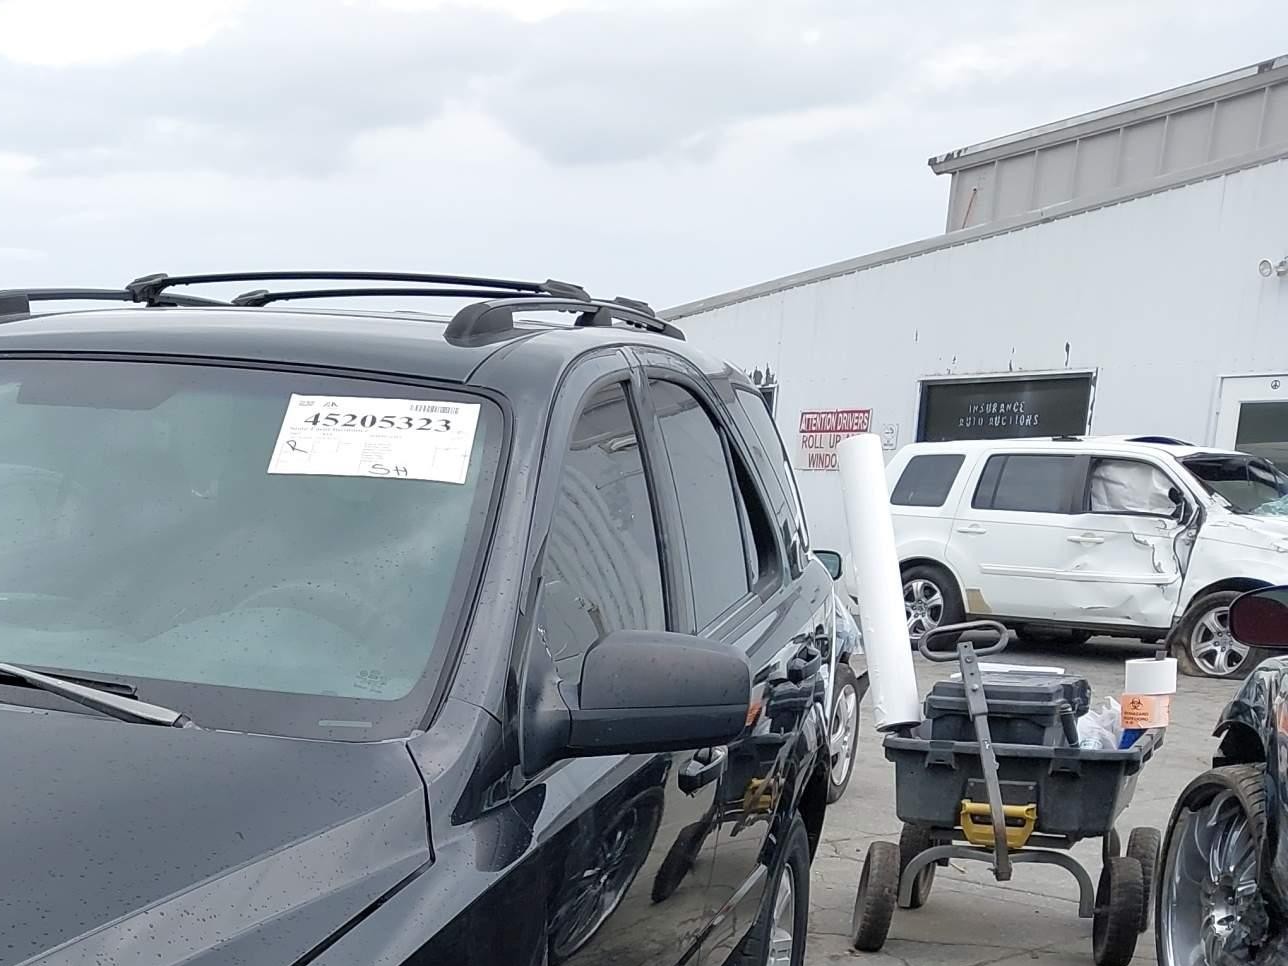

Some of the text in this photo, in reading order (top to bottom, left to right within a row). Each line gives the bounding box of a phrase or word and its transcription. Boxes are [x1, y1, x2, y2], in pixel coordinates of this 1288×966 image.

[968, 401, 1025, 415] INSURANCE
[304, 412, 452, 432] 45205323
[800, 411, 869, 431] ATTENTION DRIVERS
[802, 434, 841, 448] ROLL UP
[808, 453, 839, 468] WINDO
